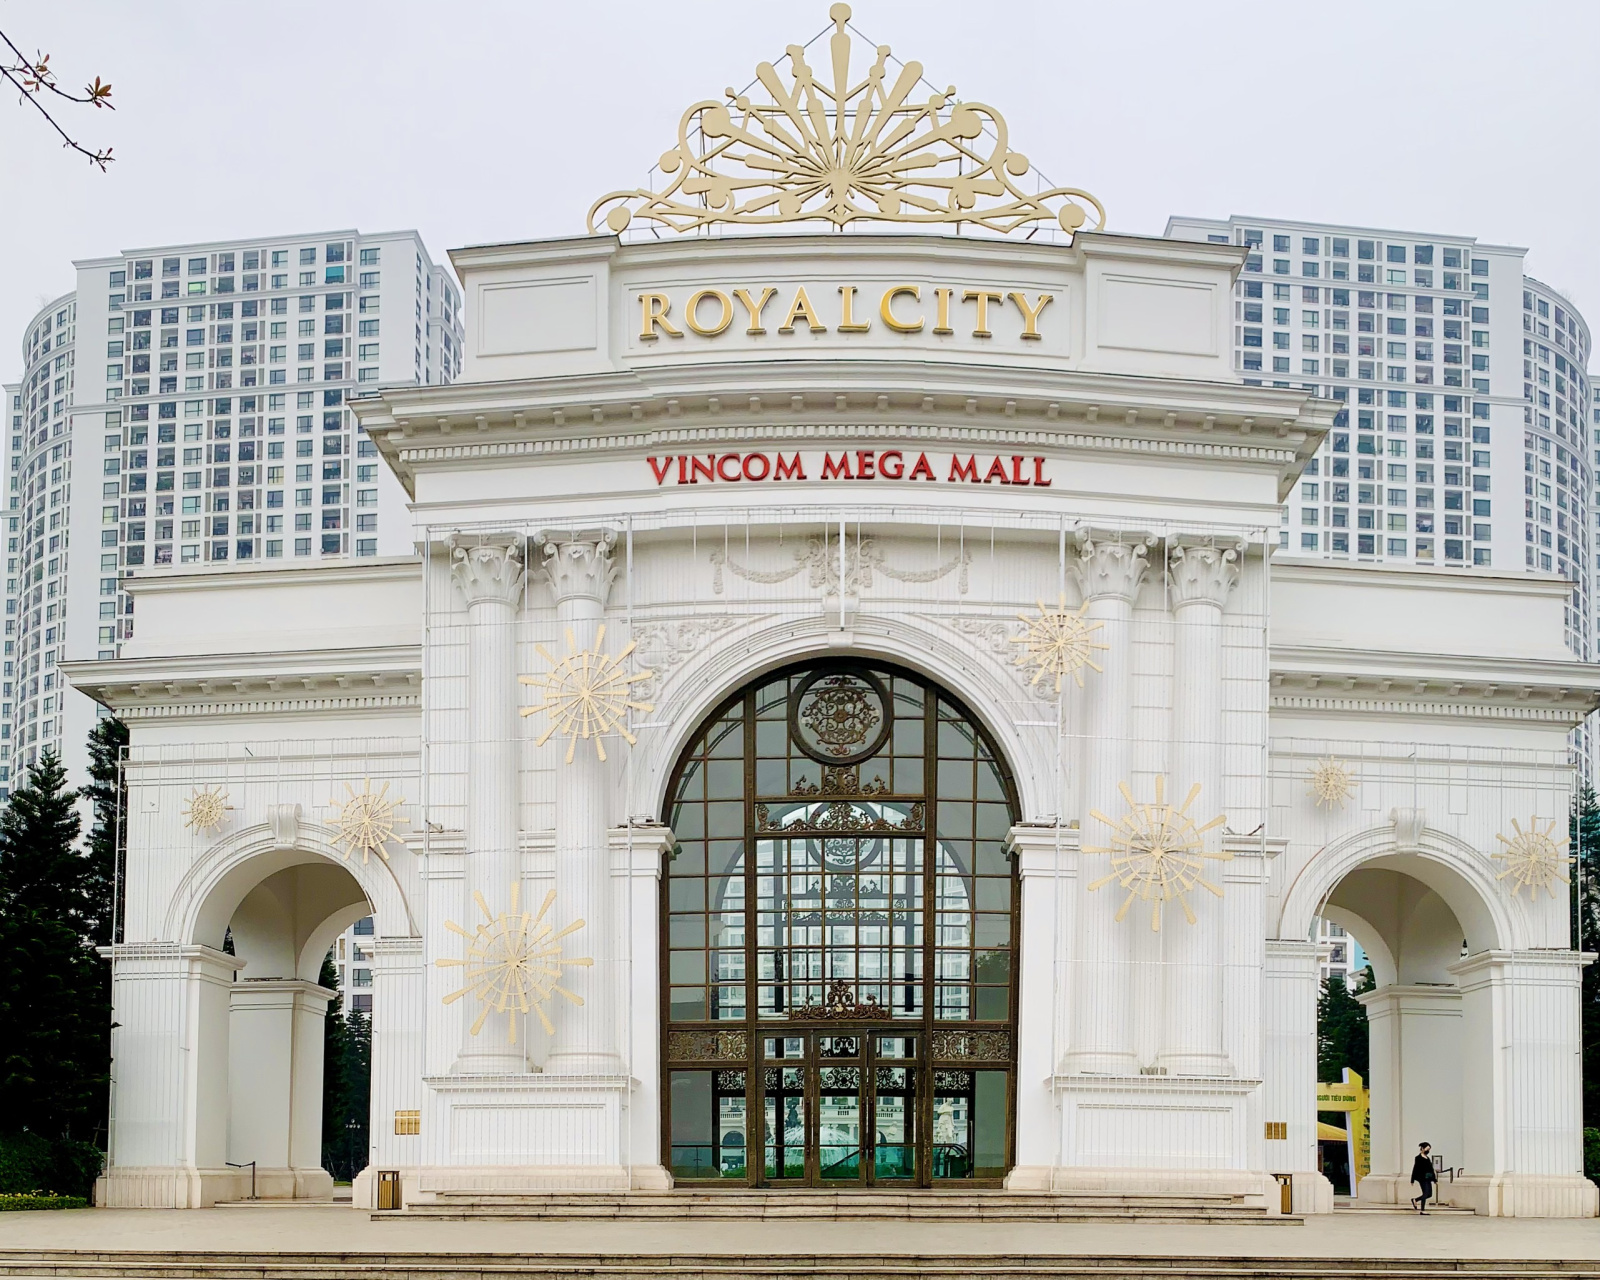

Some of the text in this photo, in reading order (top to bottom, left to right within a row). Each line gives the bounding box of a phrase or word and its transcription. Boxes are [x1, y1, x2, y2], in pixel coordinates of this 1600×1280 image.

[638, 285, 1055, 341] ROYAL CITY
[646, 450, 1052, 486] VINCOM MEGA MALL
